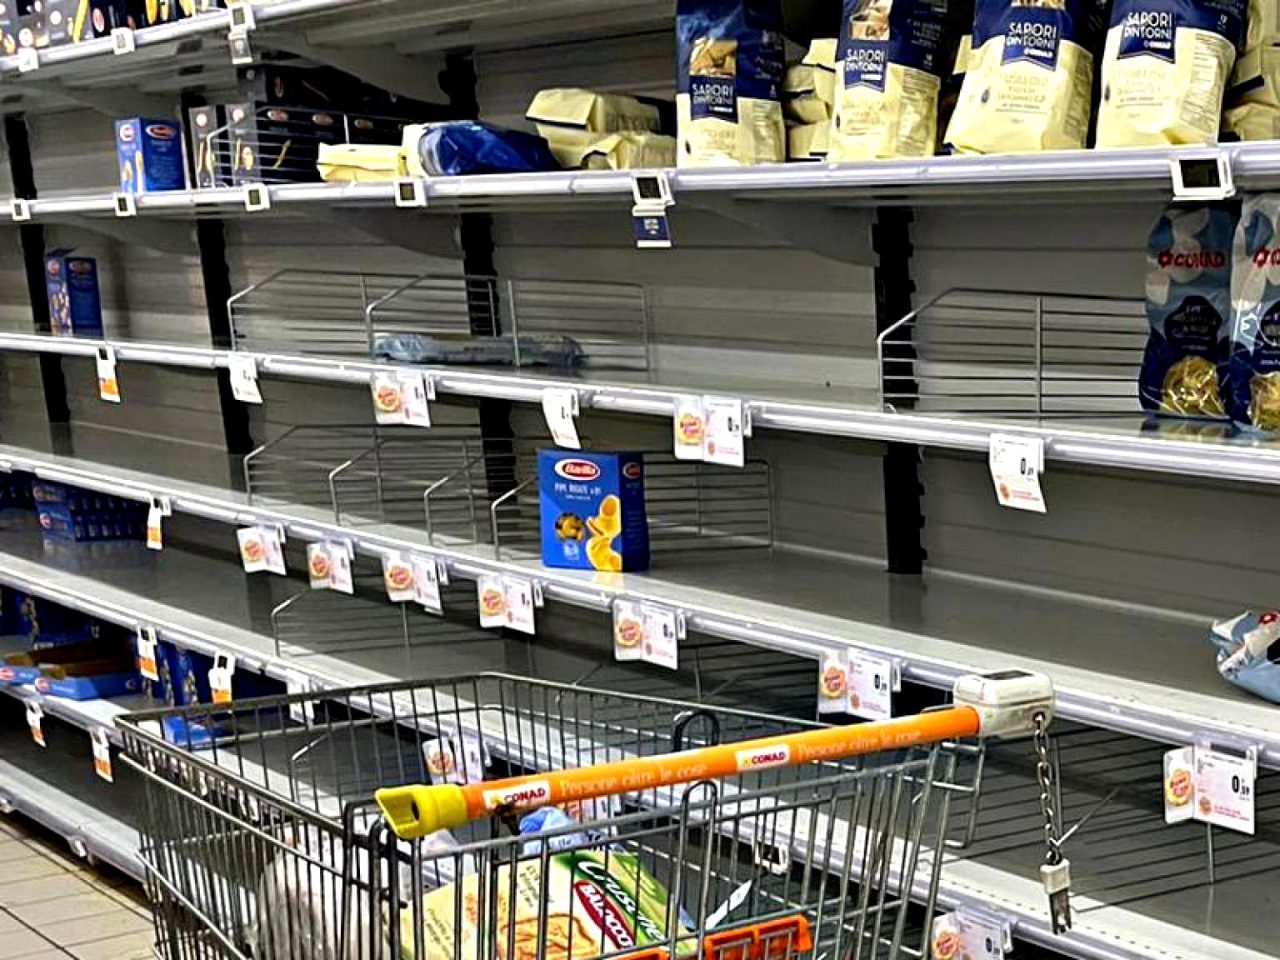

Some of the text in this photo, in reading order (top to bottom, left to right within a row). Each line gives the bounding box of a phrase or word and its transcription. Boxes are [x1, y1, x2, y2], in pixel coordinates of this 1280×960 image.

[1126, 12, 1172, 28] SAPORI
[1009, 22, 1057, 40] SAPORI
[847, 49, 884, 63] SAPORI
[692, 84, 733, 96] SAPORI
[751, 752, 786, 764] CONAD
